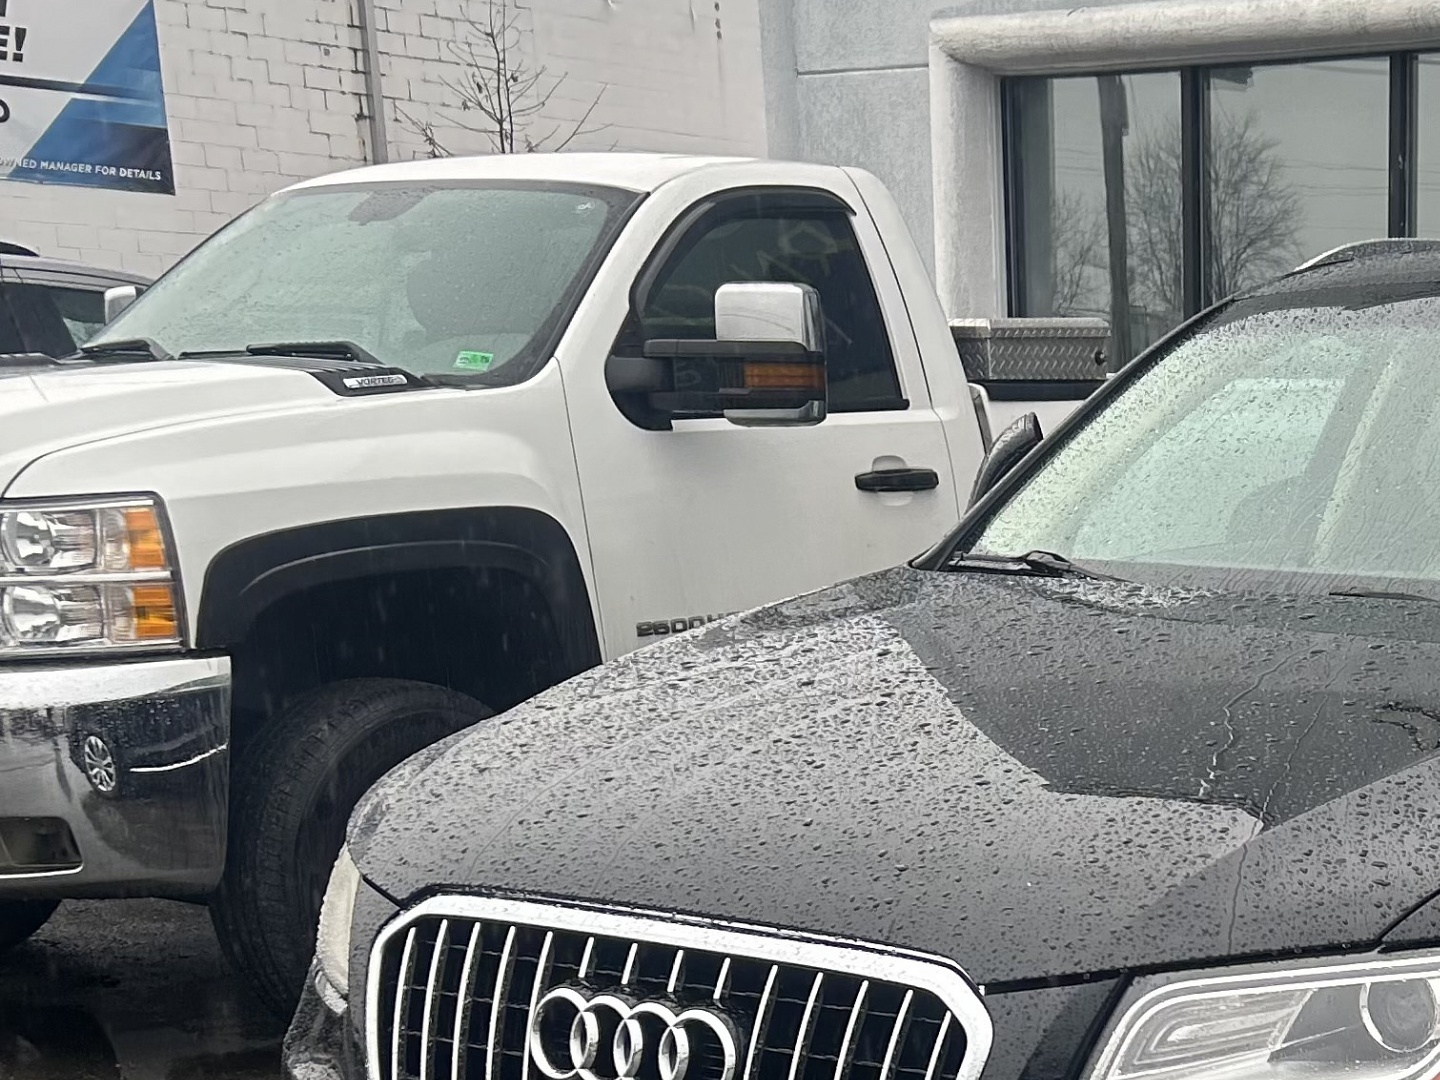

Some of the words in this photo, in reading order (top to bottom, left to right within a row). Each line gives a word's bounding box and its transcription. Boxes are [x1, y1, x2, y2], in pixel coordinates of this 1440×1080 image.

[40, 160, 92, 174] MANAGER
[95, 165, 116, 176] FOR
[119, 167, 161, 181] DETAILS
[636, 611, 745, 637] 2500
